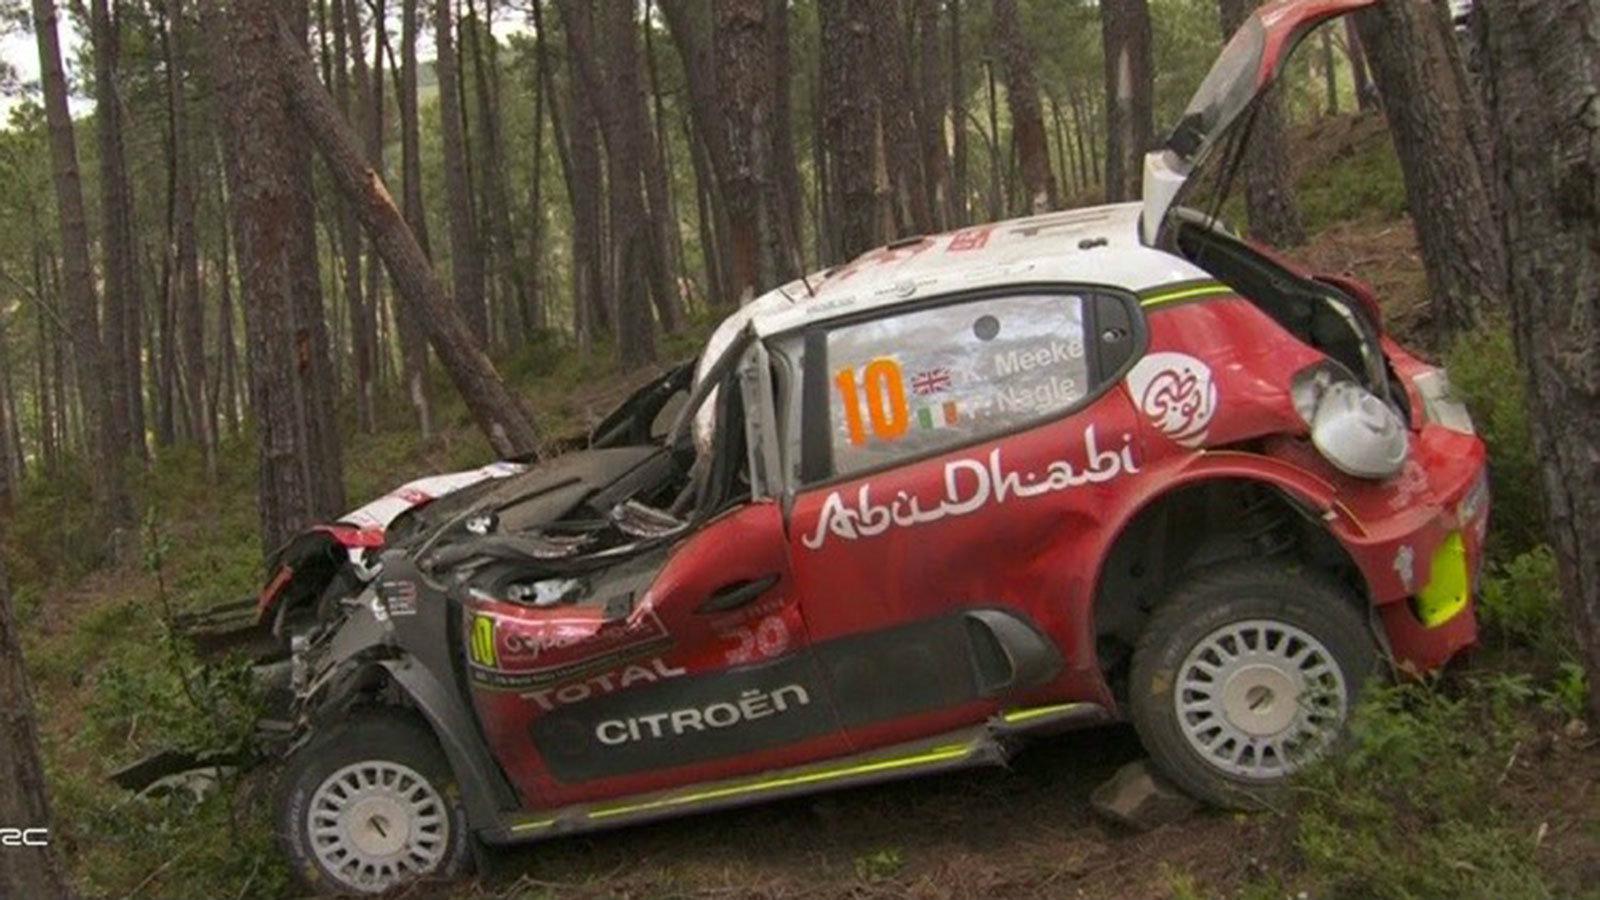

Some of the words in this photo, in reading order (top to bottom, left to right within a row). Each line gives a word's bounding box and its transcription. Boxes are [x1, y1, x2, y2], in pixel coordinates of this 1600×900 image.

[994, 341, 1084, 376] Meeke
[834, 355, 911, 447] 10
[996, 376, 1077, 416] Nagle
[520, 657, 688, 712] TOTAL
